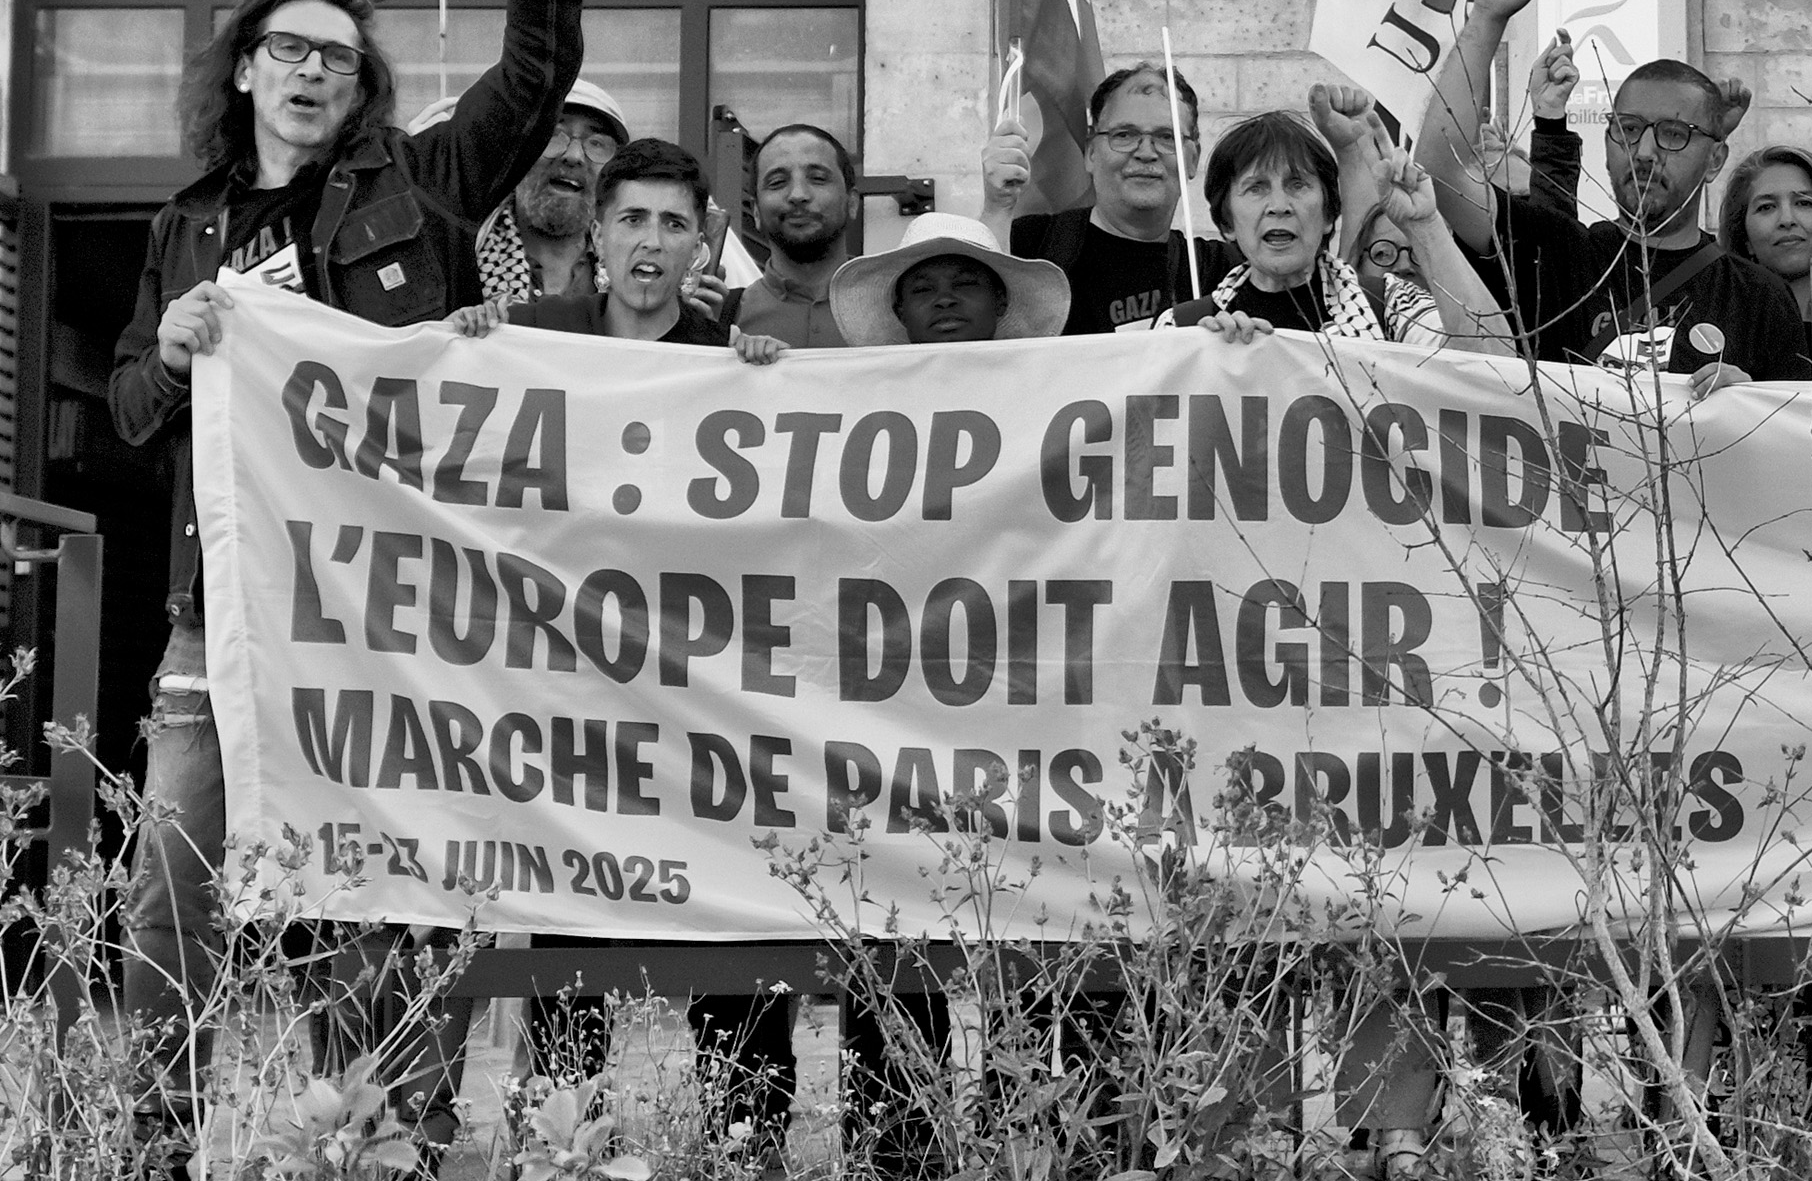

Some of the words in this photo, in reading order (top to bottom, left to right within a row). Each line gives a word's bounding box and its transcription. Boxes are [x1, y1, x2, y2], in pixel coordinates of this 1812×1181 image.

[281, 360, 570, 512] GAZA
[611, 420, 652, 516] :
[685, 409, 1002, 523] STOP
[1040, 394, 1613, 534] GENOCIDE
[838, 575, 1113, 707] DOIT
[1151, 580, 1434, 709] AGIR
[290, 687, 661, 817] MARCHE
[686, 731, 797, 830] DE
[823, 740, 1104, 847] PARIS
[441, 838, 554, 894] JUIN
[561, 848, 693, 904] 2025
